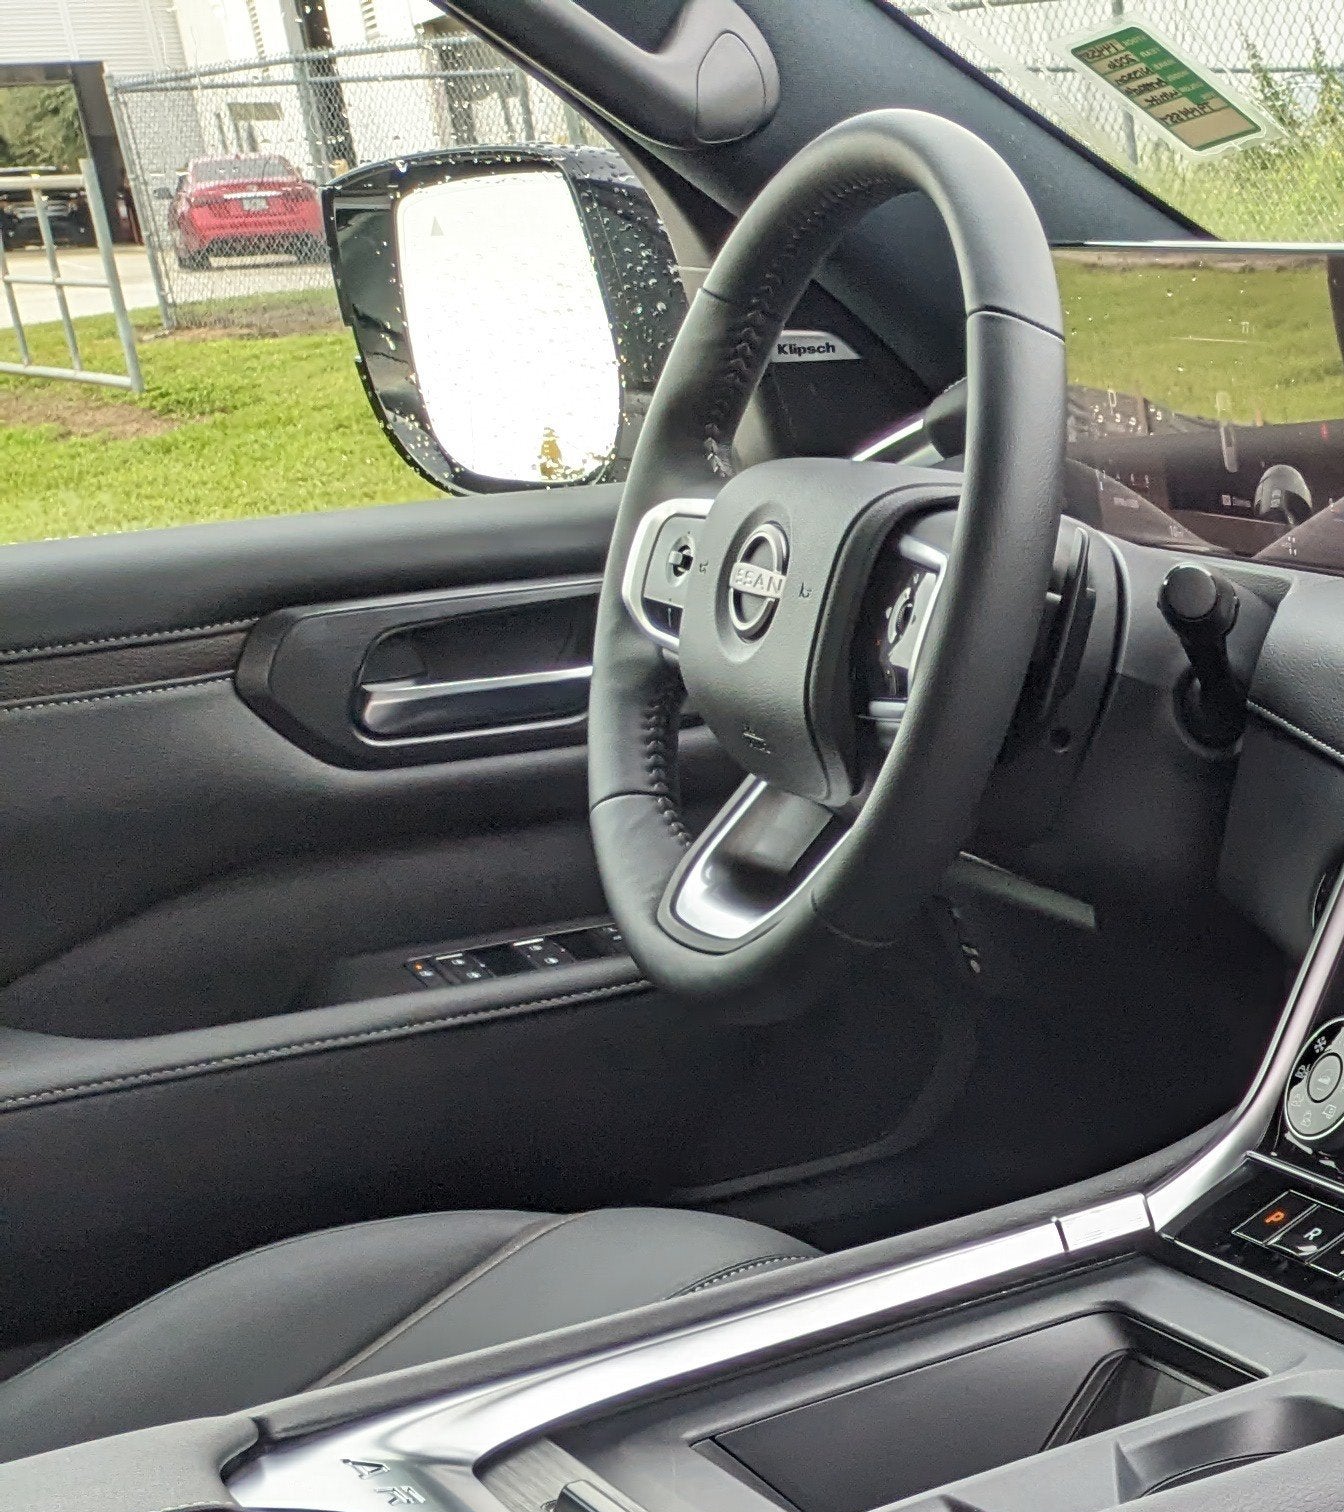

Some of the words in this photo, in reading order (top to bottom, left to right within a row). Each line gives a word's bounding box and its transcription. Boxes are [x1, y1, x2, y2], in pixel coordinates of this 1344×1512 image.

[777, 341, 836, 357] Klipsch
[1264, 1210, 1286, 1225] P
[1303, 1227, 1323, 1241] R
